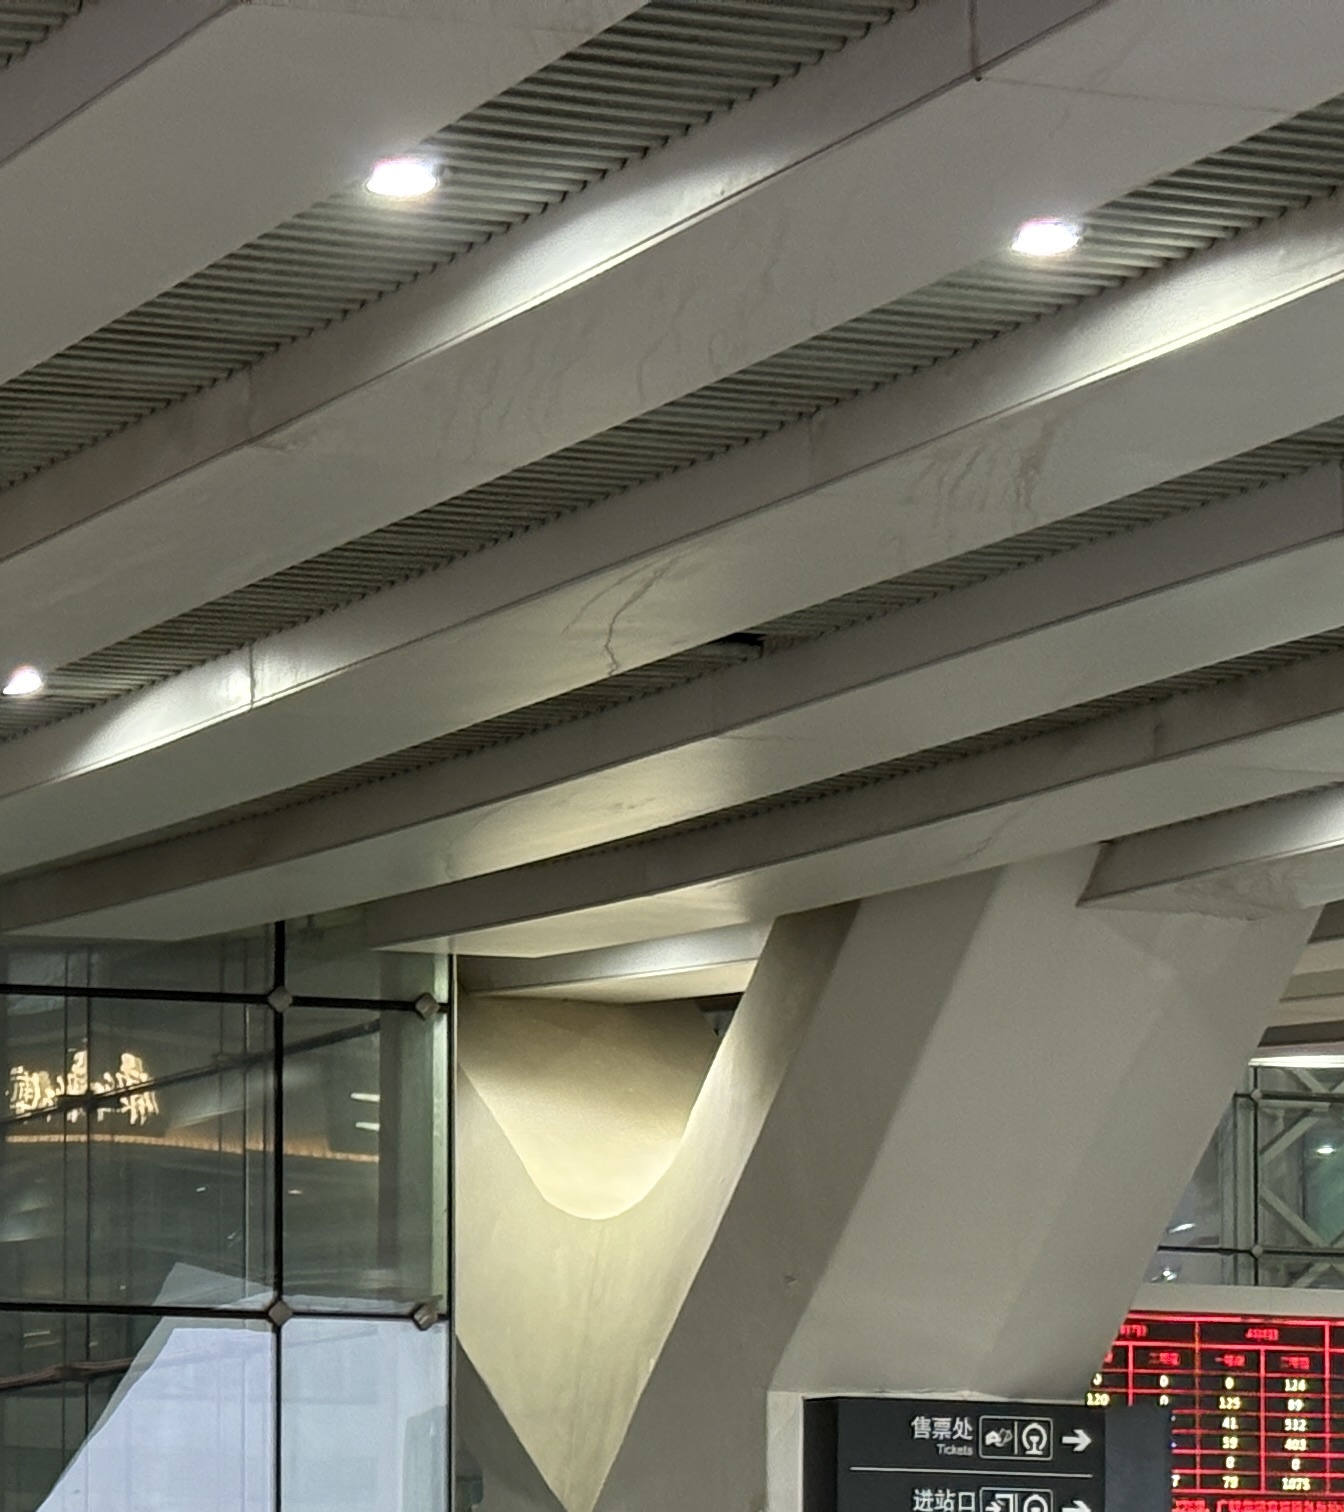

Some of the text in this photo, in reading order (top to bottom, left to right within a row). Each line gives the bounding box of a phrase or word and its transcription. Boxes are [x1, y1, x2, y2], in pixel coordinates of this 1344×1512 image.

[911, 1416, 973, 1440] 售票处
[936, 1443, 973, 1456] Tickets
[913, 1488, 976, 1512] 进站口
